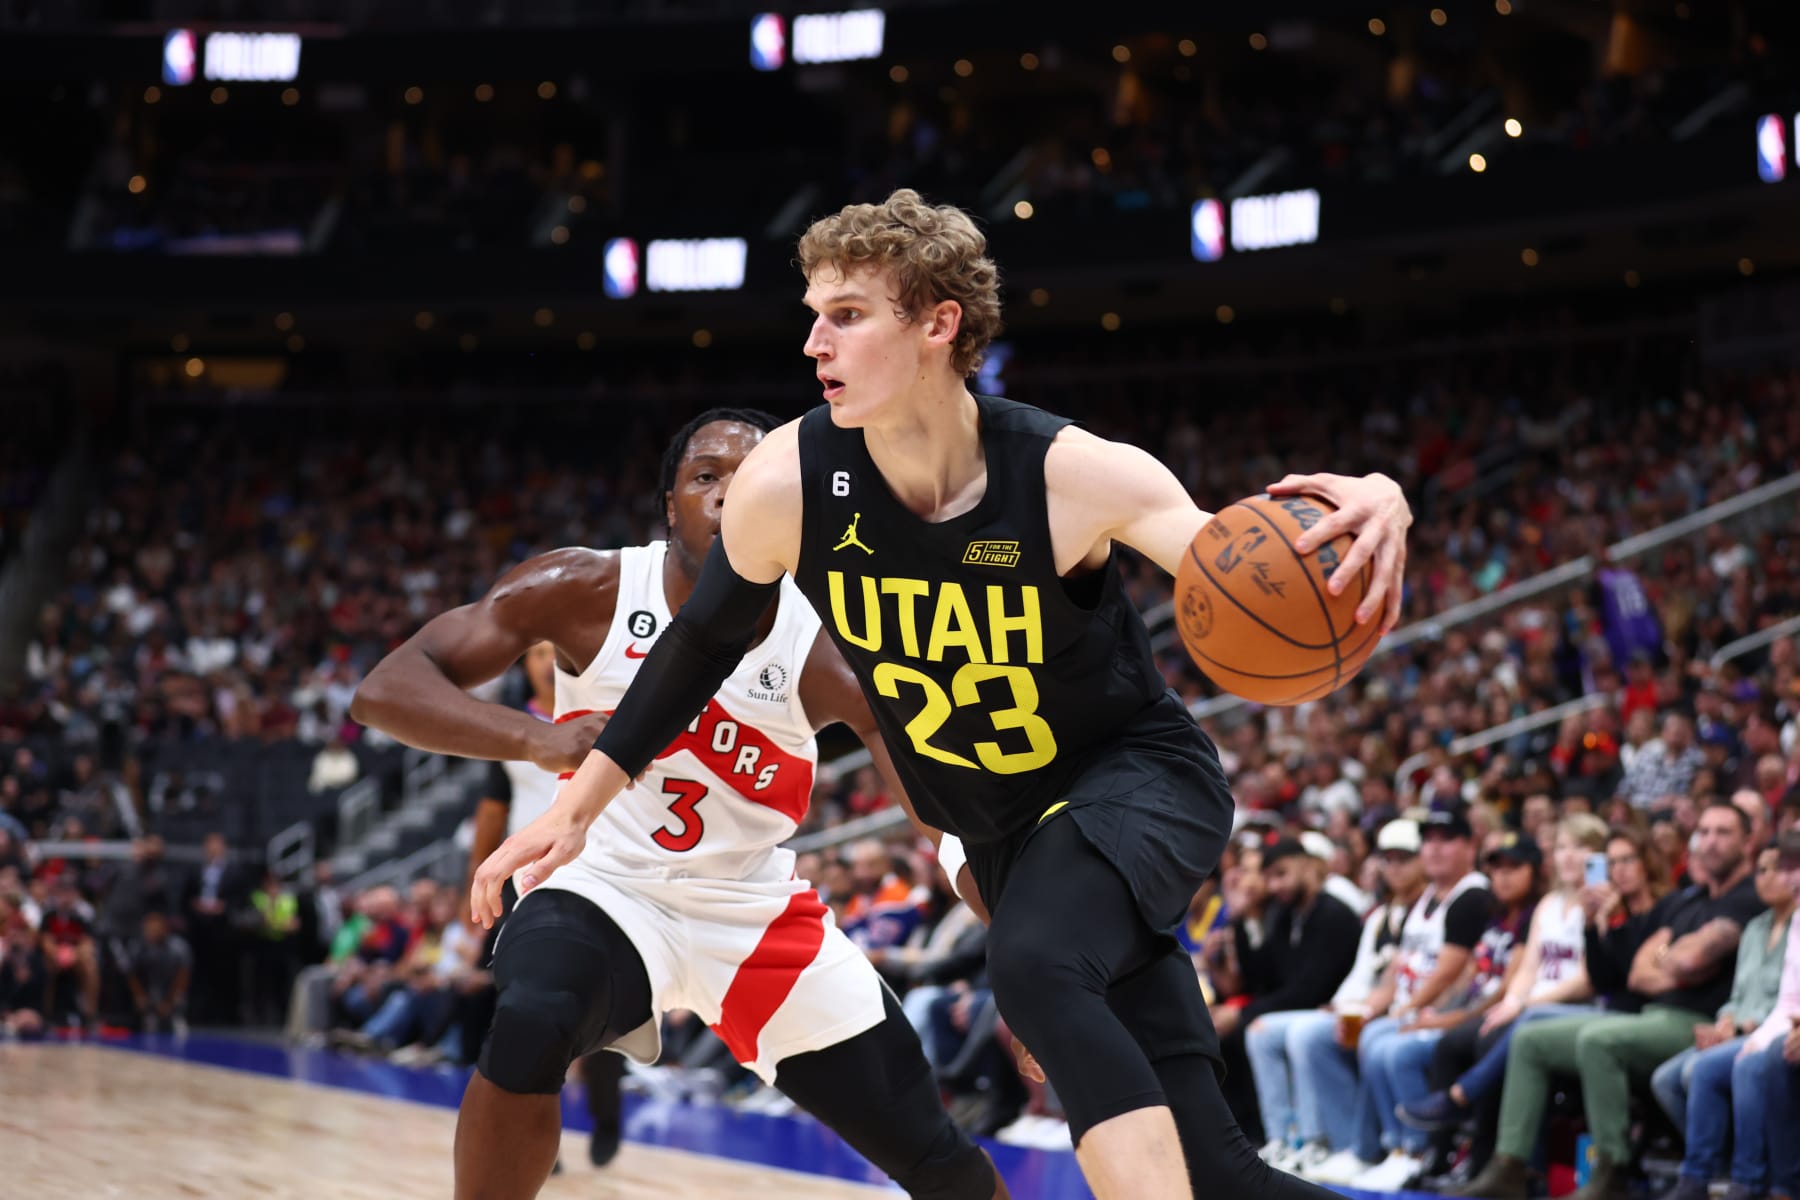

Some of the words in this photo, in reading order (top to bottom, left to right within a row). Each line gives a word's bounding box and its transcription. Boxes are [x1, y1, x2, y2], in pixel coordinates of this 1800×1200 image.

[832, 471, 850, 497] 6
[969, 544, 983, 560] 5
[984, 553, 1015, 563] FIGHT
[633, 614, 652, 636] 6
[827, 571, 1043, 664] UTAH
[747, 689, 768, 701] Sun
[770, 692, 789, 703] Life
[873, 662, 1057, 775] 23
[650, 776, 709, 853] 3
